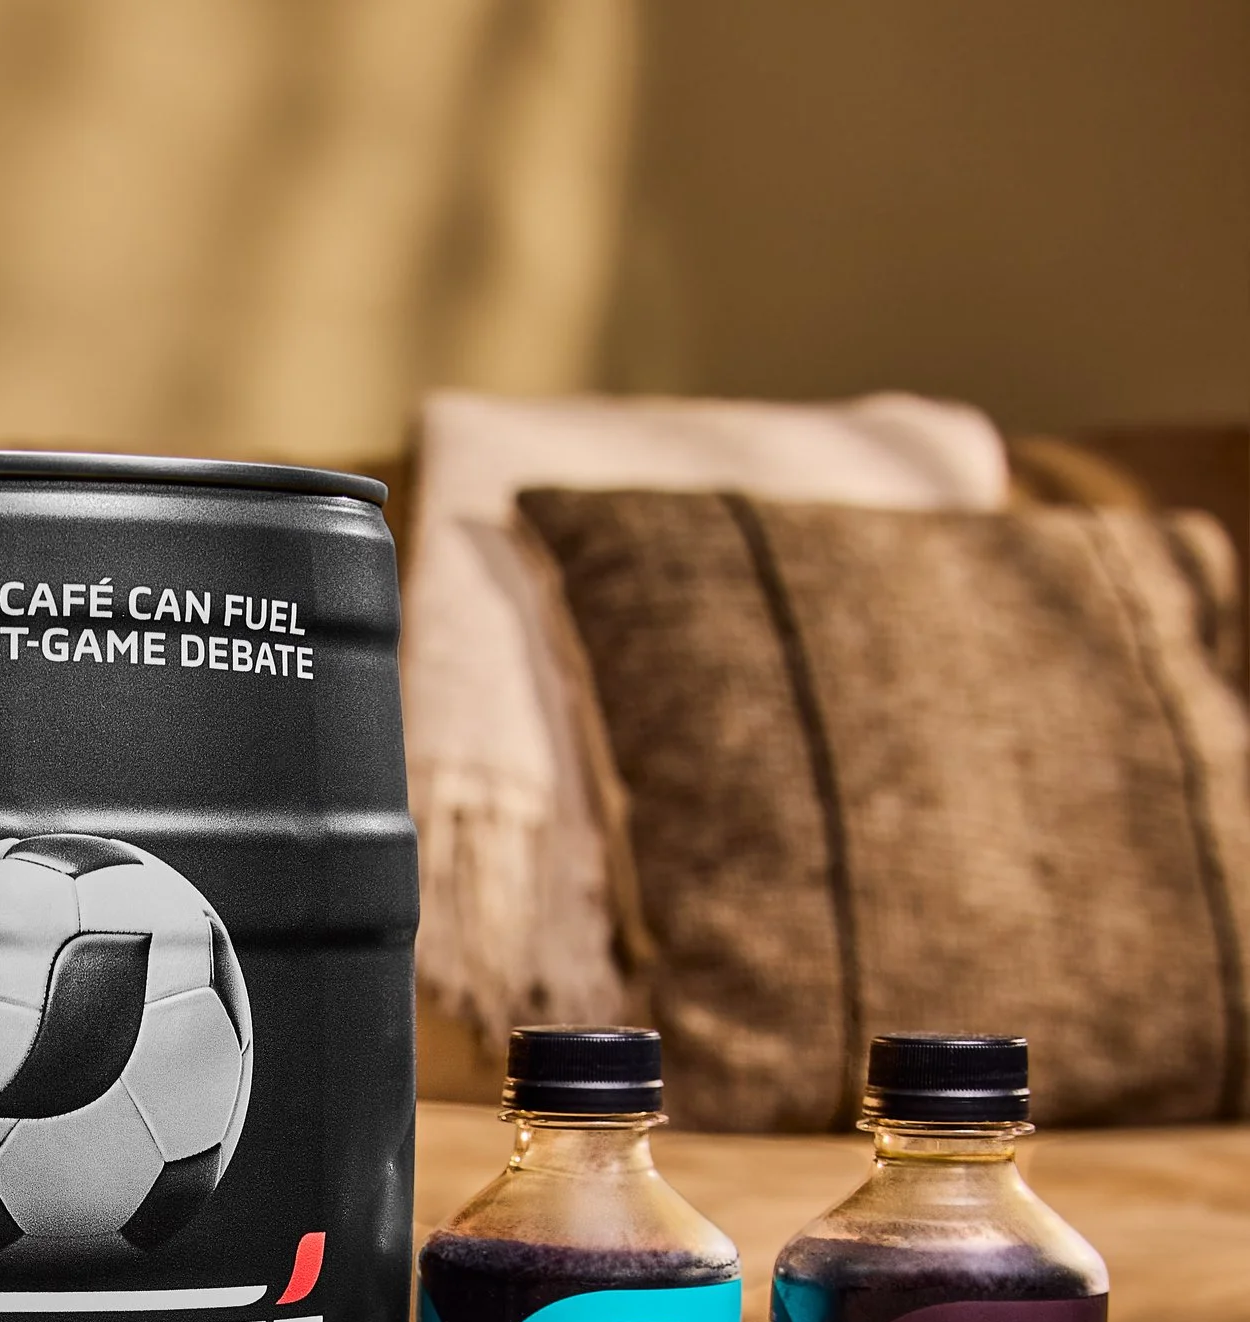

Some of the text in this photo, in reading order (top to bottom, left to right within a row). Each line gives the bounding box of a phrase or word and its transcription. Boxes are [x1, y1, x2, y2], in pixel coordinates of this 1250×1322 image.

[127, 584, 212, 624] CAN
[223, 594, 306, 636] FUEL
[180, 633, 314, 680] DEBATE
